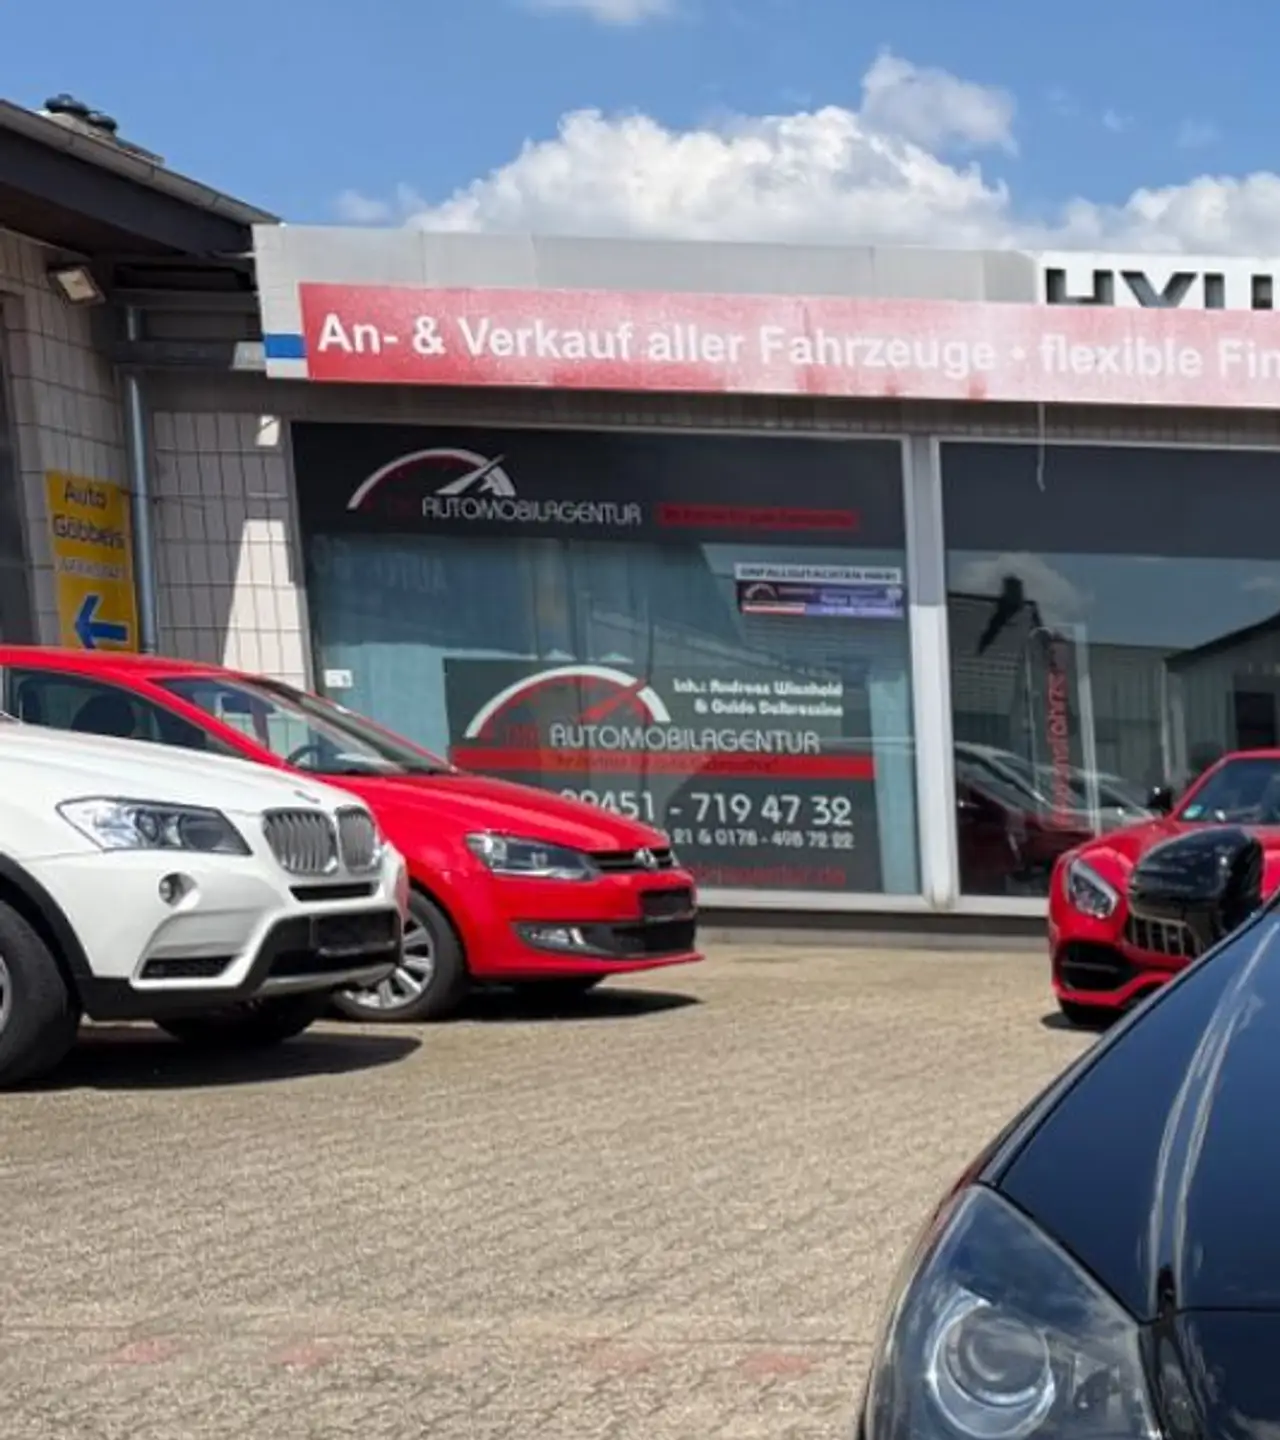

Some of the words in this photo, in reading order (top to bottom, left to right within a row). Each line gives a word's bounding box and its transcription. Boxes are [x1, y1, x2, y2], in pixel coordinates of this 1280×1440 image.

[318, 313, 399, 354] An-
[412, 315, 446, 355] &
[457, 317, 633, 361] Verkauf
[647, 323, 743, 363] aller
[759, 325, 995, 379] Fahrzeuge
[1039, 333, 1203, 379] flexible
[64, 480, 108, 511] Auto
[421, 496, 642, 526] AUTOMOBILAGENTUR
[549, 722, 822, 755] AUTOMOBILAGENTUR
[690, 792, 752, 824] 719
[761, 795, 801, 825] 47
[811, 796, 854, 827] 32
